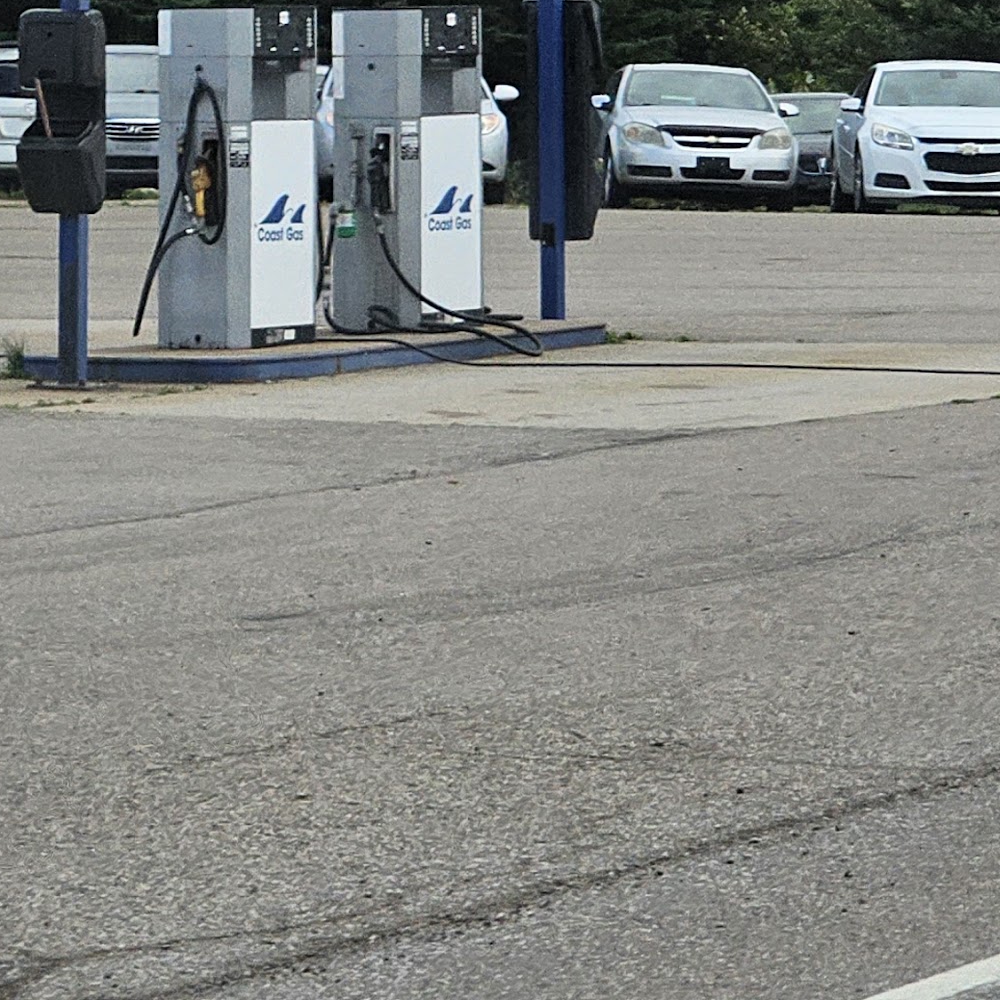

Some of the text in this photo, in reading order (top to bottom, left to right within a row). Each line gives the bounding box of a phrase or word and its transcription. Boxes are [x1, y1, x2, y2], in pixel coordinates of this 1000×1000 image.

[428, 216, 472, 231] Coast Gas
[258, 226, 304, 242] Coast Gas
